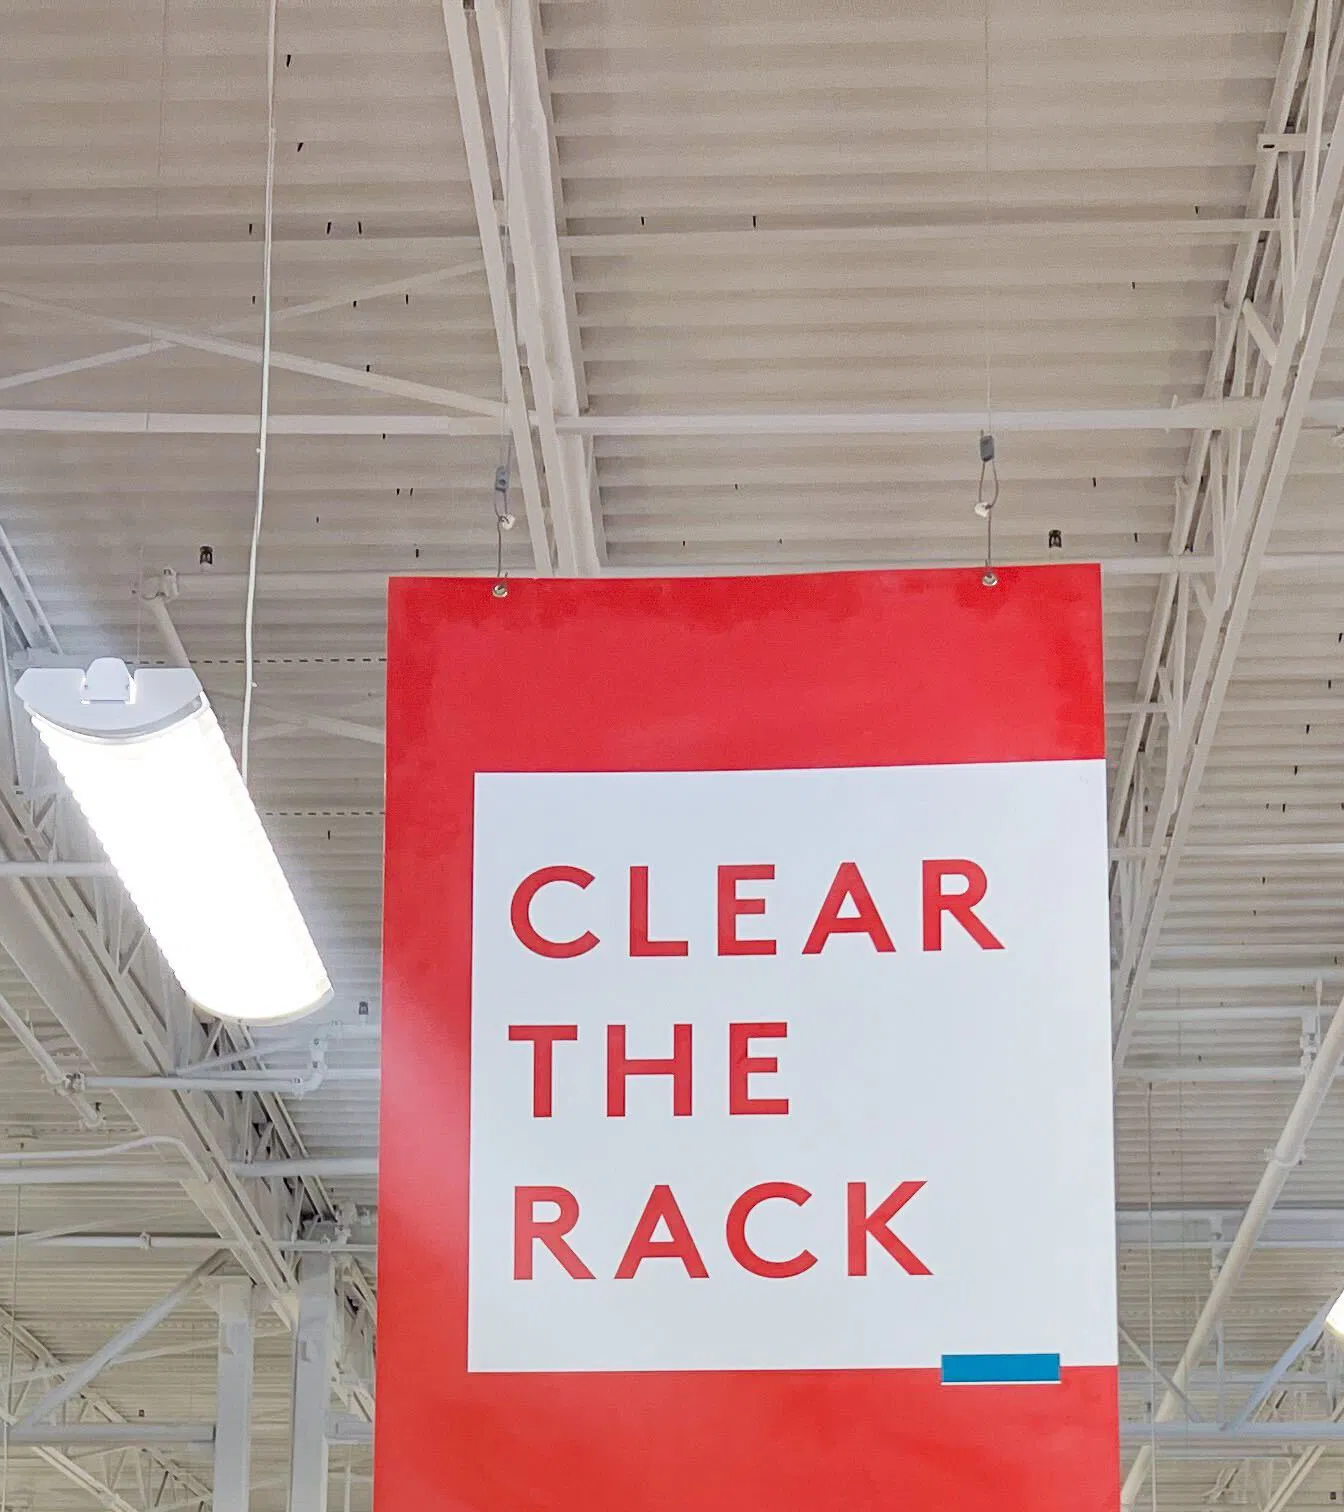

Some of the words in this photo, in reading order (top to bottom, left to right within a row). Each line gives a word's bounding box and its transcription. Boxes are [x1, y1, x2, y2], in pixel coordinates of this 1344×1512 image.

[511, 860, 1005, 959] CLEAR
[509, 1022, 790, 1118] THE
[514, 1181, 932, 1281] RACK
